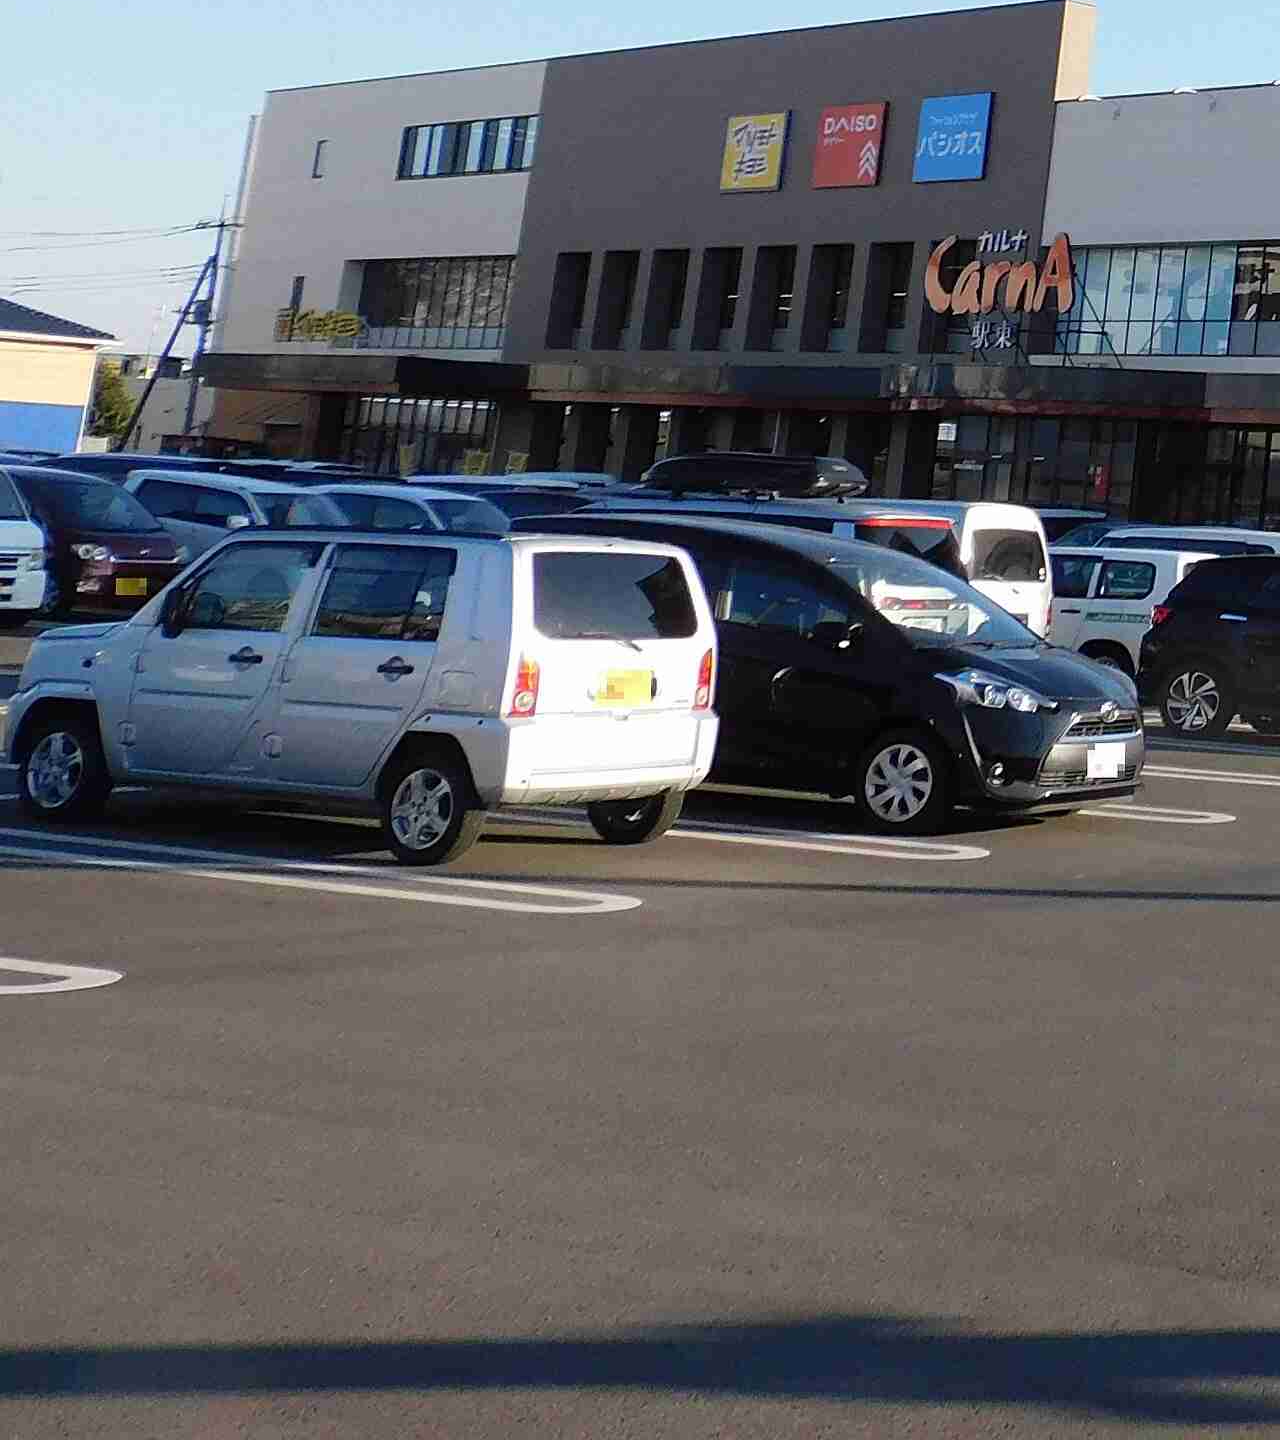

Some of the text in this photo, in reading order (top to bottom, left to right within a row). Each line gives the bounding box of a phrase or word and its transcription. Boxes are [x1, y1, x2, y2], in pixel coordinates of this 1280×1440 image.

[824, 114, 877, 135] DAISO
[917, 131, 983, 157] パシオス
[978, 229, 1029, 252] カルナ
[925, 232, 1074, 315] CarnA
[970, 320, 1016, 349] 駅東
